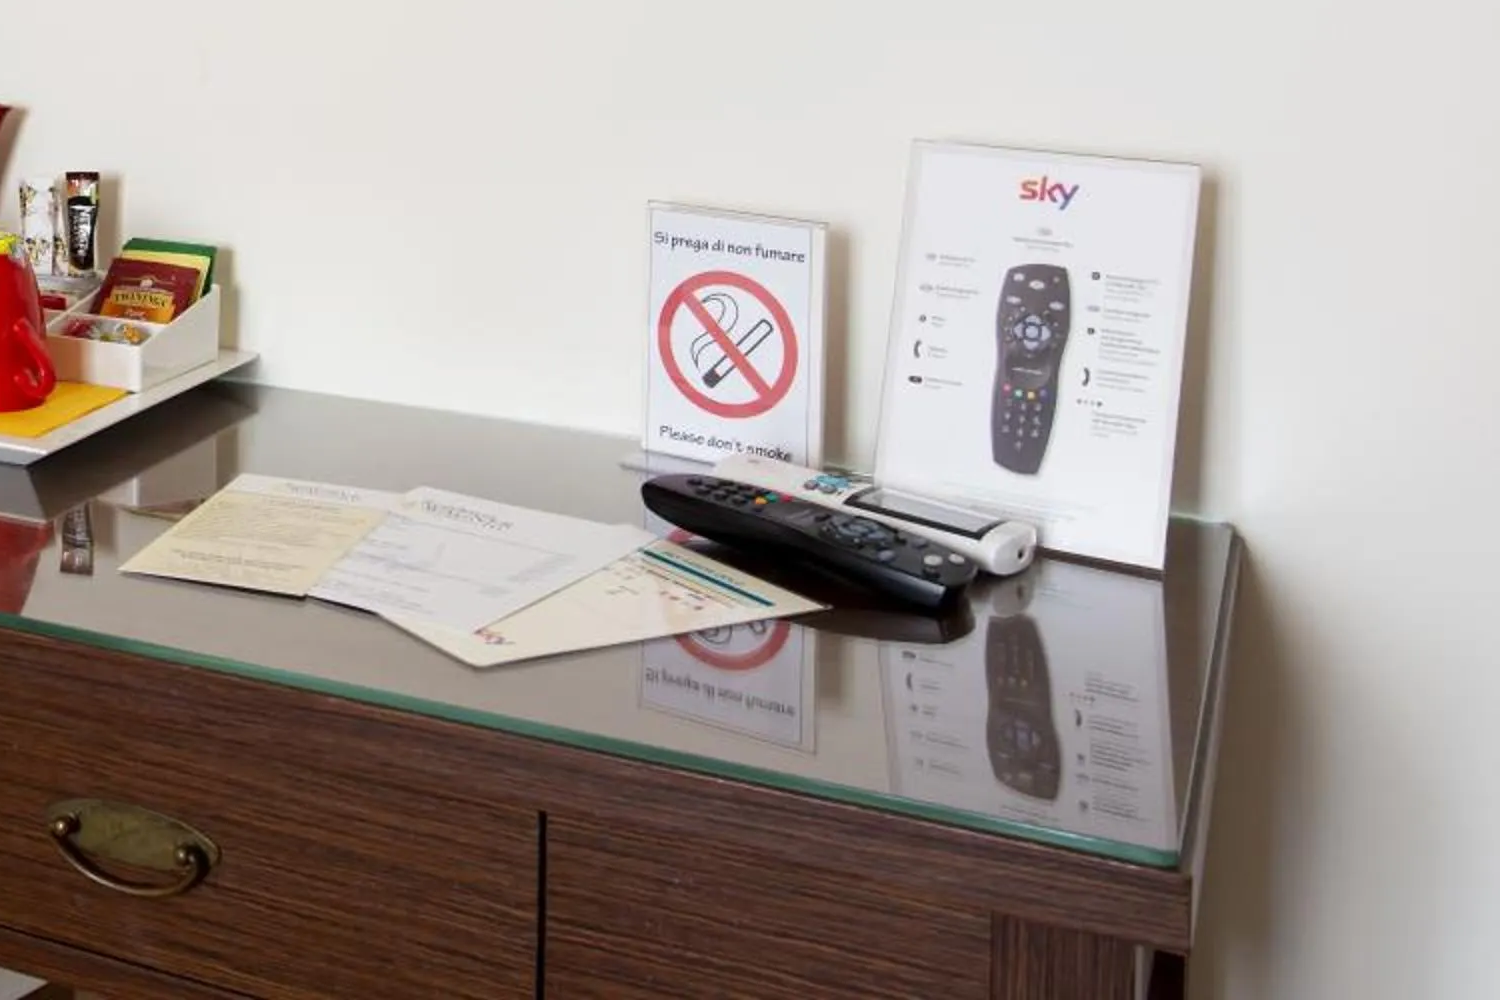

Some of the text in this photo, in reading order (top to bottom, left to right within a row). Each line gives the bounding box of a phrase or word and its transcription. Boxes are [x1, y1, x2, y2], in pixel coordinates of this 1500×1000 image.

[1019, 176, 1079, 210] sky
[654, 231, 805, 263] Si prega di non fumare
[659, 425, 705, 445] Please
[707, 436, 741, 453] don't
